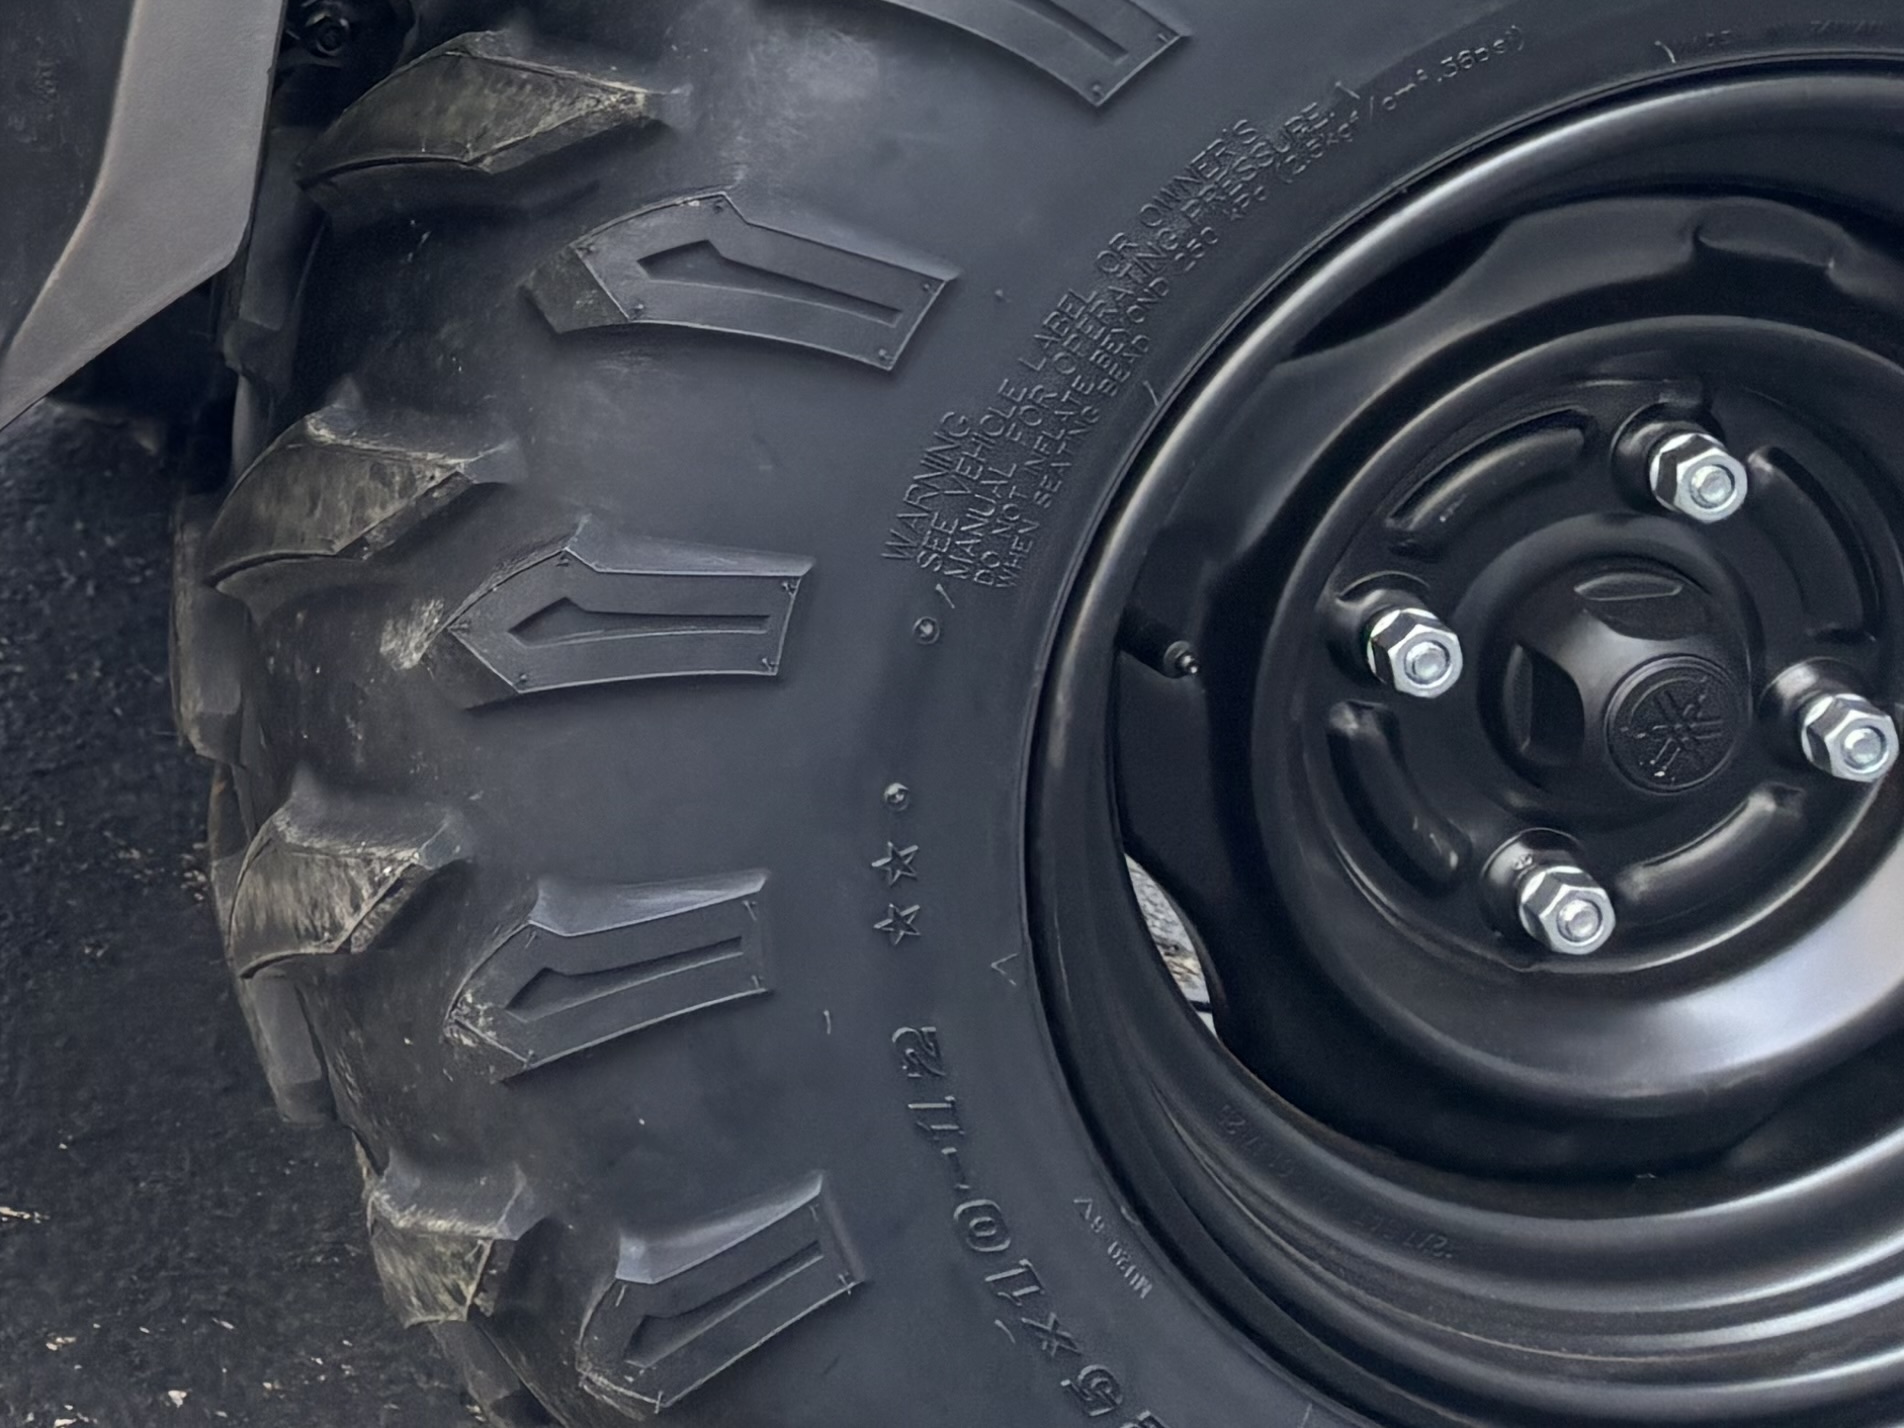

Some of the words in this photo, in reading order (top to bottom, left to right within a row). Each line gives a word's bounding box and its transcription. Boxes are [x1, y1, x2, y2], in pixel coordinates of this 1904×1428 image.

[879, 411, 971, 561] WARNING
[915, 517, 961, 573] SEE
[943, 377, 1029, 495] VEHICLE
[1017, 287, 1099, 373] LABEL
[1095, 231, 1140, 274] OR
[1137, 117, 1261, 228] OWNER'S
[943, 462, 1020, 579] MANUAL
[1005, 385, 1059, 442] FOR
[1051, 227, 1181, 375] OPERATING
[972, 548, 1001, 587] DO
[989, 483, 1030, 541] NOT
[1022, 373, 1094, 478] INFLATE
[1088, 276, 1170, 371] BEYOND
[1173, 225, 1219, 273] 250
[993, 517, 1042, 589] WHEN
[1033, 405, 1101, 510] SEATING
[1095, 333, 1153, 398] BEAD
